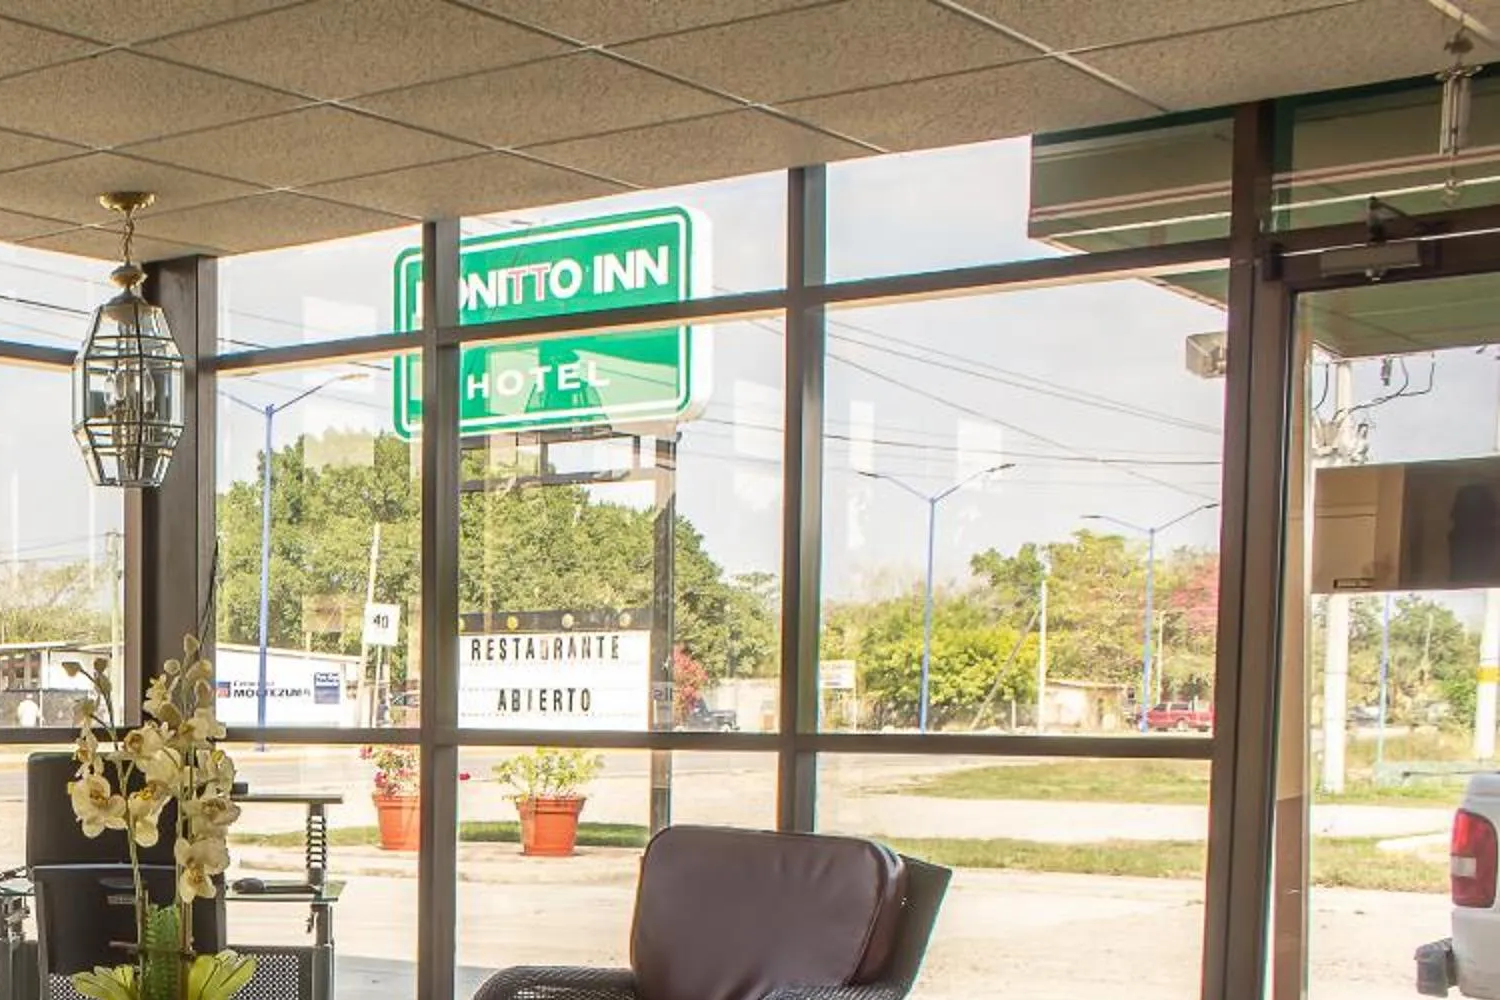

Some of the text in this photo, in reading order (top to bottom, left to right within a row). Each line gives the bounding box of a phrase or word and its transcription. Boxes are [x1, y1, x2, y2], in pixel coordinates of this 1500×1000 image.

[415, 246, 669, 318] NITTO INN
[466, 359, 610, 400] HOTEL
[471, 635, 620, 661] RESTAURANTE
[497, 688, 592, 713] ABIERTO
